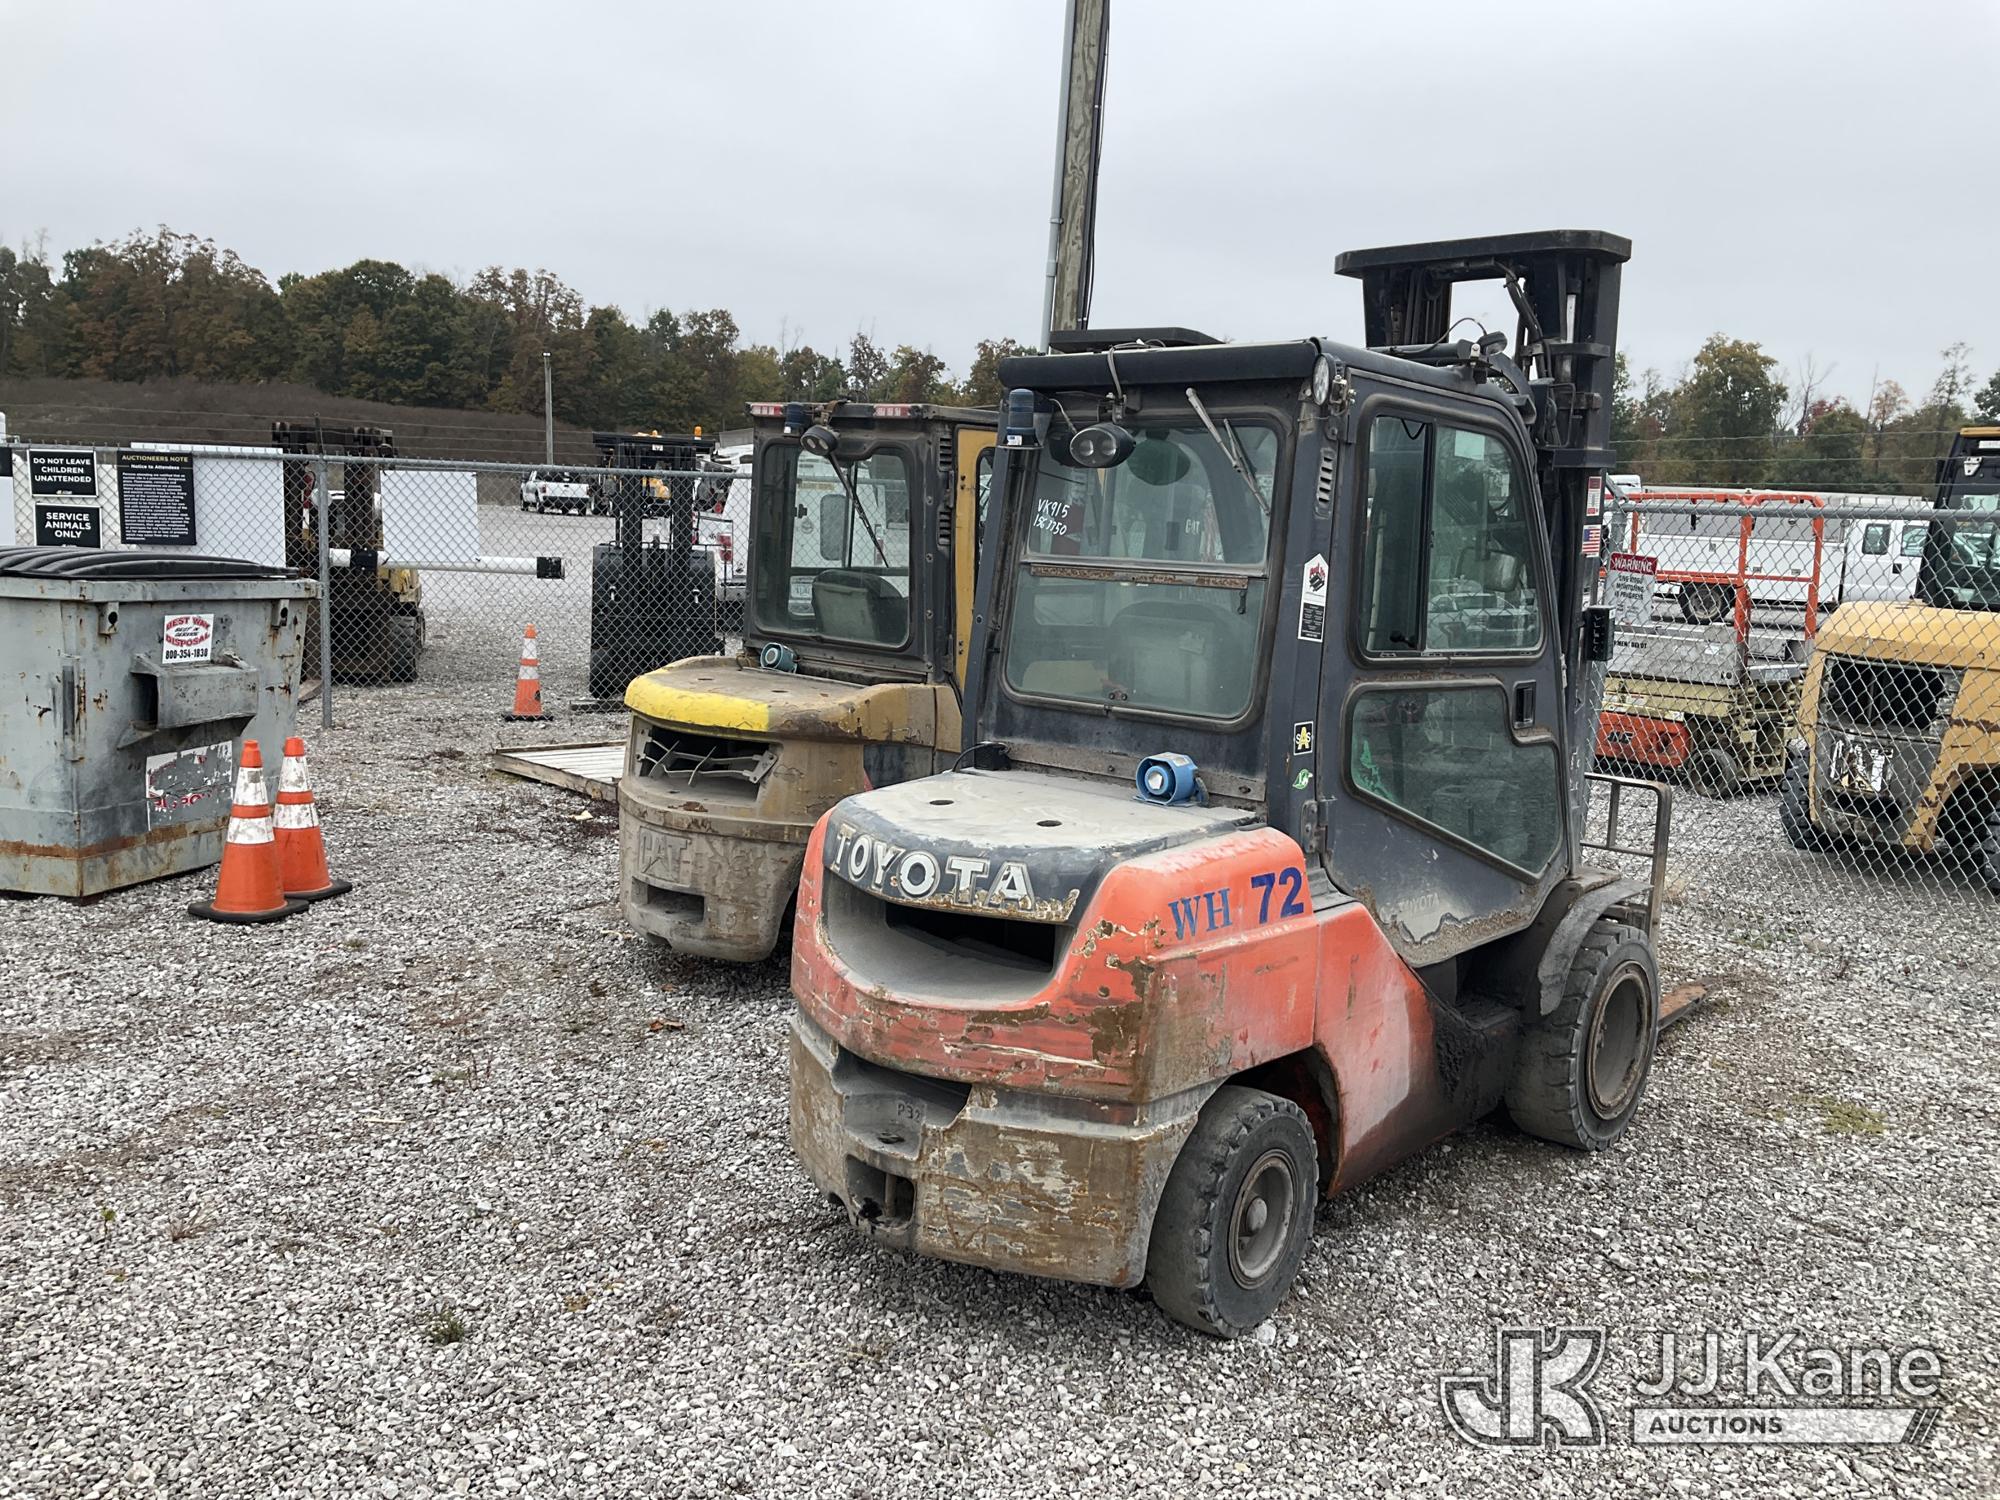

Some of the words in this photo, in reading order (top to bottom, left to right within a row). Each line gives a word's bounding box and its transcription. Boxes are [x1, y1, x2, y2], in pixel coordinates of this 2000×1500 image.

[121, 454, 169, 462] AUCTIONEERS
[41, 466, 84, 474] CHILDREN
[34, 475, 92, 483] UNATTENDED
[1037, 498, 1071, 519] VK915
[46, 512, 90, 522] SERVICE
[45, 521, 92, 530] ANIMALS
[54, 530, 82, 539] ONLY
[1614, 557, 1653, 573] WARNING
[166, 632, 210, 648] DISPOSAL
[831, 823, 1035, 911] TOYOTA
[1168, 888, 1233, 941] WH
[1251, 867, 1304, 925] 72
